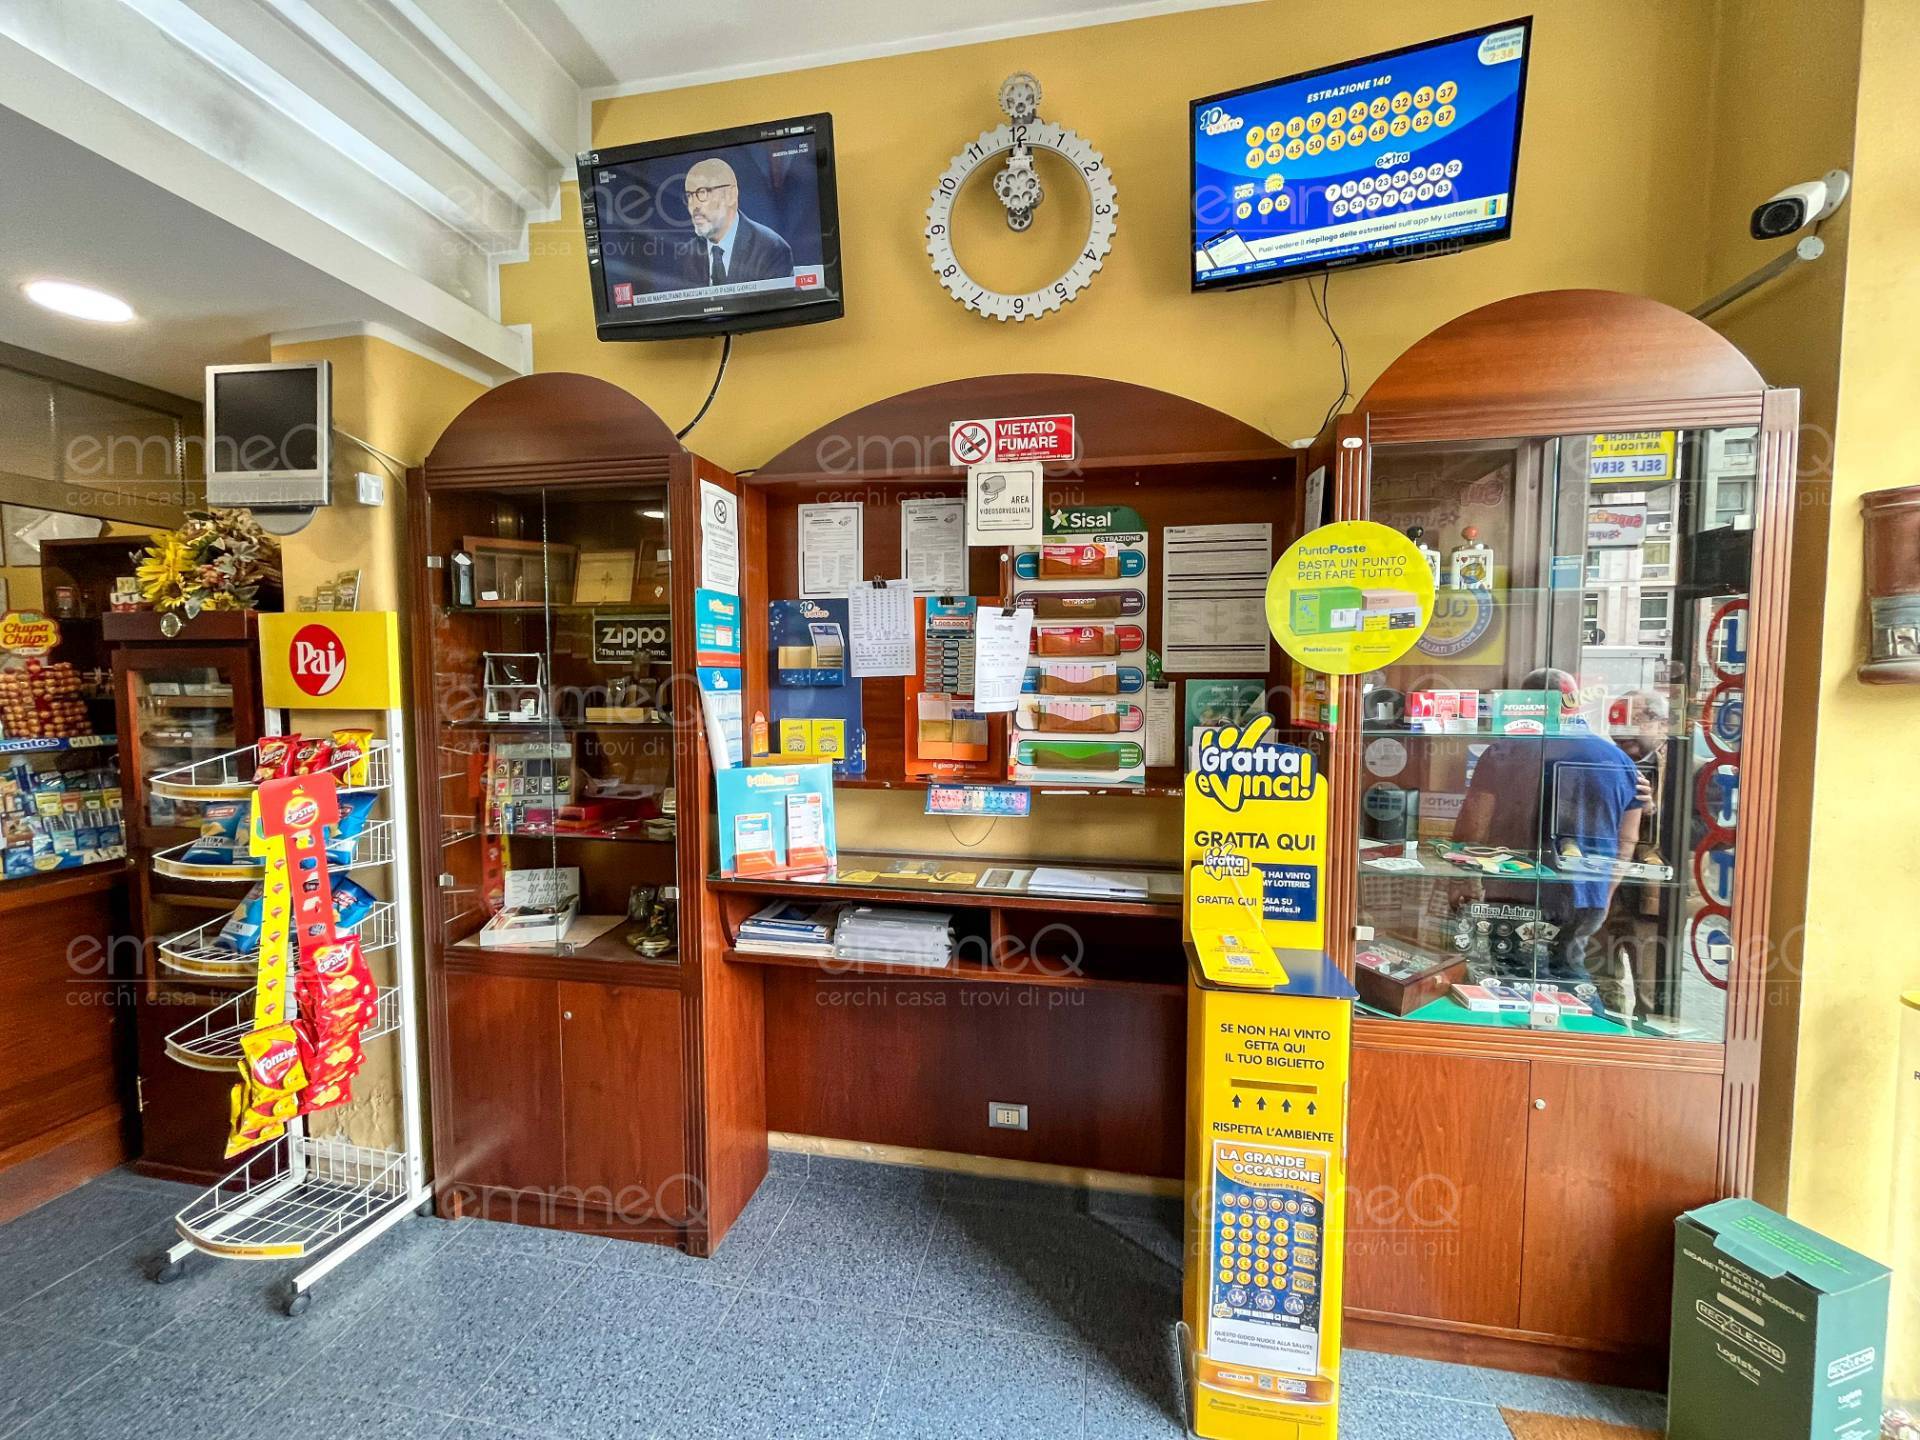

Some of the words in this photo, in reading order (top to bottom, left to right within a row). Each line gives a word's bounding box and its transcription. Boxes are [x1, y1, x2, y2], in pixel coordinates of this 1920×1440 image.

[1307, 79, 1371, 104] ESTRAZIONE
[1372, 75, 1392, 88] 140
[1252, 132, 1258, 141] 9
[1270, 127, 1280, 137] 12
[1290, 122, 1300, 131] 18
[1311, 117, 1321, 127] 19
[1331, 112, 1342, 123] 21
[1351, 107, 1364, 118] 24
[1373, 102, 1386, 113] 26
[1394, 97, 1408, 109] 32
[1417, 92, 1430, 103] 33
[1439, 86, 1453, 98] 37
[1009, 125, 1028, 142] 12
[1056, 132, 1066, 147] 1
[1249, 153, 1260, 163] 41
[1268, 148, 1280, 158] 43
[1288, 144, 1300, 154] 45
[1309, 139, 1321, 150] 50
[1330, 135, 1341, 145] 51
[1350, 130, 1363, 141] 64
[1371, 125, 1385, 136] 68
[1393, 121, 1406, 132] 73
[1415, 115, 1429, 126] 82
[1438, 110, 1452, 121] 87
[968, 143, 985, 161] 11
[1376, 152, 1409, 167] extra
[1083, 160, 1099, 177] 2
[939, 177, 956, 197] 10
[1330, 188, 1336, 197] 7
[1345, 185, 1354, 193] 14
[1362, 181, 1371, 190] 16
[1378, 177, 1389, 187] 23
[1394, 174, 1407, 184] 34
[1412, 170, 1424, 180] 36
[1429, 166, 1442, 176] 42
[1447, 163, 1460, 173] 52
[1334, 203, 1346, 213] 53
[1351, 200, 1363, 210] 54
[1368, 196, 1379, 206] 57
[1386, 193, 1395, 203] 71
[1401, 189, 1413, 200] 74
[1420, 186, 1430, 197] 81
[1437, 183, 1449, 193] 83
[1095, 204, 1111, 216] 3
[930, 223, 946, 235] 9
[1275, 240, 1300, 251] vedere
[1305, 233, 1339, 248] riepilogo
[1339, 229, 1358, 239] delle
[1358, 222, 1397, 236] estrazioni
[1430, 214, 1442, 223] My
[1444, 207, 1478, 219] Lotteries
[1083, 248, 1098, 262] 4
[942, 264, 957, 278] 8
[970, 290, 984, 307] 7
[1054, 282, 1068, 299] 5
[1013, 298, 1024, 314] 6
[998, 420, 1056, 436] VIETATO
[998, 436, 1058, 451] FUMARE
[1010, 495, 1030, 505] AREA
[979, 506, 1031, 516] VIDEOSORVEGLIATA
[1070, 511, 1112, 529] Sisal
[1095, 534, 1141, 543] ESTRAZIONE
[1298, 544, 1366, 556] PuntoPoste
[1298, 559, 1335, 570] BASTA
[1340, 558, 1358, 567] UN
[1362, 556, 1407, 567] PUNTO
[1298, 570, 1322, 581] PER
[1325, 569, 1356, 579] FARE
[3, 623, 49, 635] Chupa
[3, 633, 49, 646] Chups
[1201, 746, 1300, 774] Gratta
[1198, 775, 1210, 793] e
[1193, 831, 1270, 850] GRATTA
[1276, 834, 1317, 851] QUI
[1206, 854, 1244, 868] Gratta
[1268, 871, 1284, 879] HAI
[1285, 871, 1311, 880] VINTO
[1273, 880, 1311, 889] LOTTERIES
[1196, 895, 1235, 905] GRATTA
[1237, 897, 1257, 907] QUI
[1281, 898, 1293, 906] SU
[1470, 903, 1500, 918] Glass
[1220, 1023, 1234, 1033] SE
[1237, 1025, 1266, 1036] NON
[1269, 1027, 1291, 1037] HAI
[1294, 1029, 1331, 1041] VINTO
[1244, 1040, 1279, 1052] GETTA
[1283, 1043, 1305, 1054] QUI
[1225, 1053, 1234, 1063] IL
[1238, 1054, 1263, 1065] TUO
[1266, 1056, 1325, 1070] BIGLIETTO
[1212, 1122, 1263, 1136] RISPETTA
[1266, 1127, 1334, 1142] L'AMBIENTE
[1220, 1148, 1240, 1161] LA
[1243, 1151, 1305, 1168] GRANDE
[1232, 1163, 1321, 1184] OCCASIONE
[1717, 1258, 1766, 1290] RACCOLTA
[1720, 1277, 1763, 1307] ESAUSTE
[1214, 1330, 1237, 1339] QUESTO
[1237, 1333, 1256, 1341] GIOCO
[1256, 1336, 1276, 1344] NUOCE
[1277, 1339, 1291, 1347] ALLA
[1291, 1341, 1313, 1350] SALUTE
[1715, 1342, 1761, 1377] Logista
